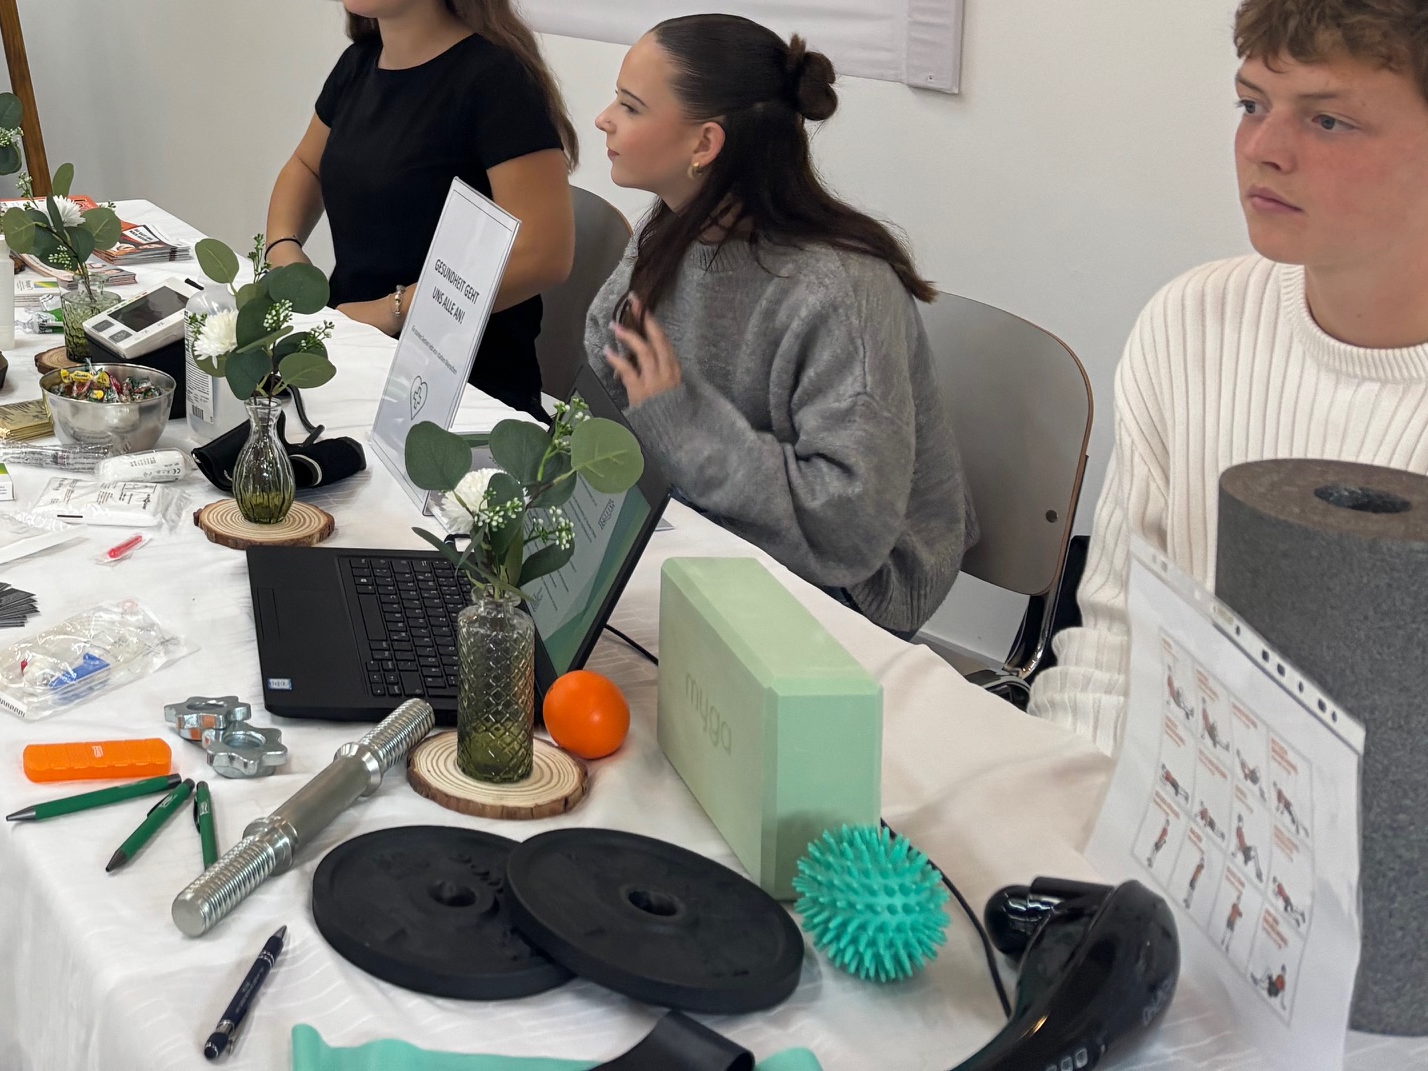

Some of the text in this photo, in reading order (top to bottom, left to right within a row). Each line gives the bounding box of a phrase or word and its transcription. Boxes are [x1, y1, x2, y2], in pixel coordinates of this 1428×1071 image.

[434, 258, 480, 305] GESUNDHEIT GEHT
[432, 286, 466, 325] UNS ALLE AN!
[684, 671, 732, 759] myga
